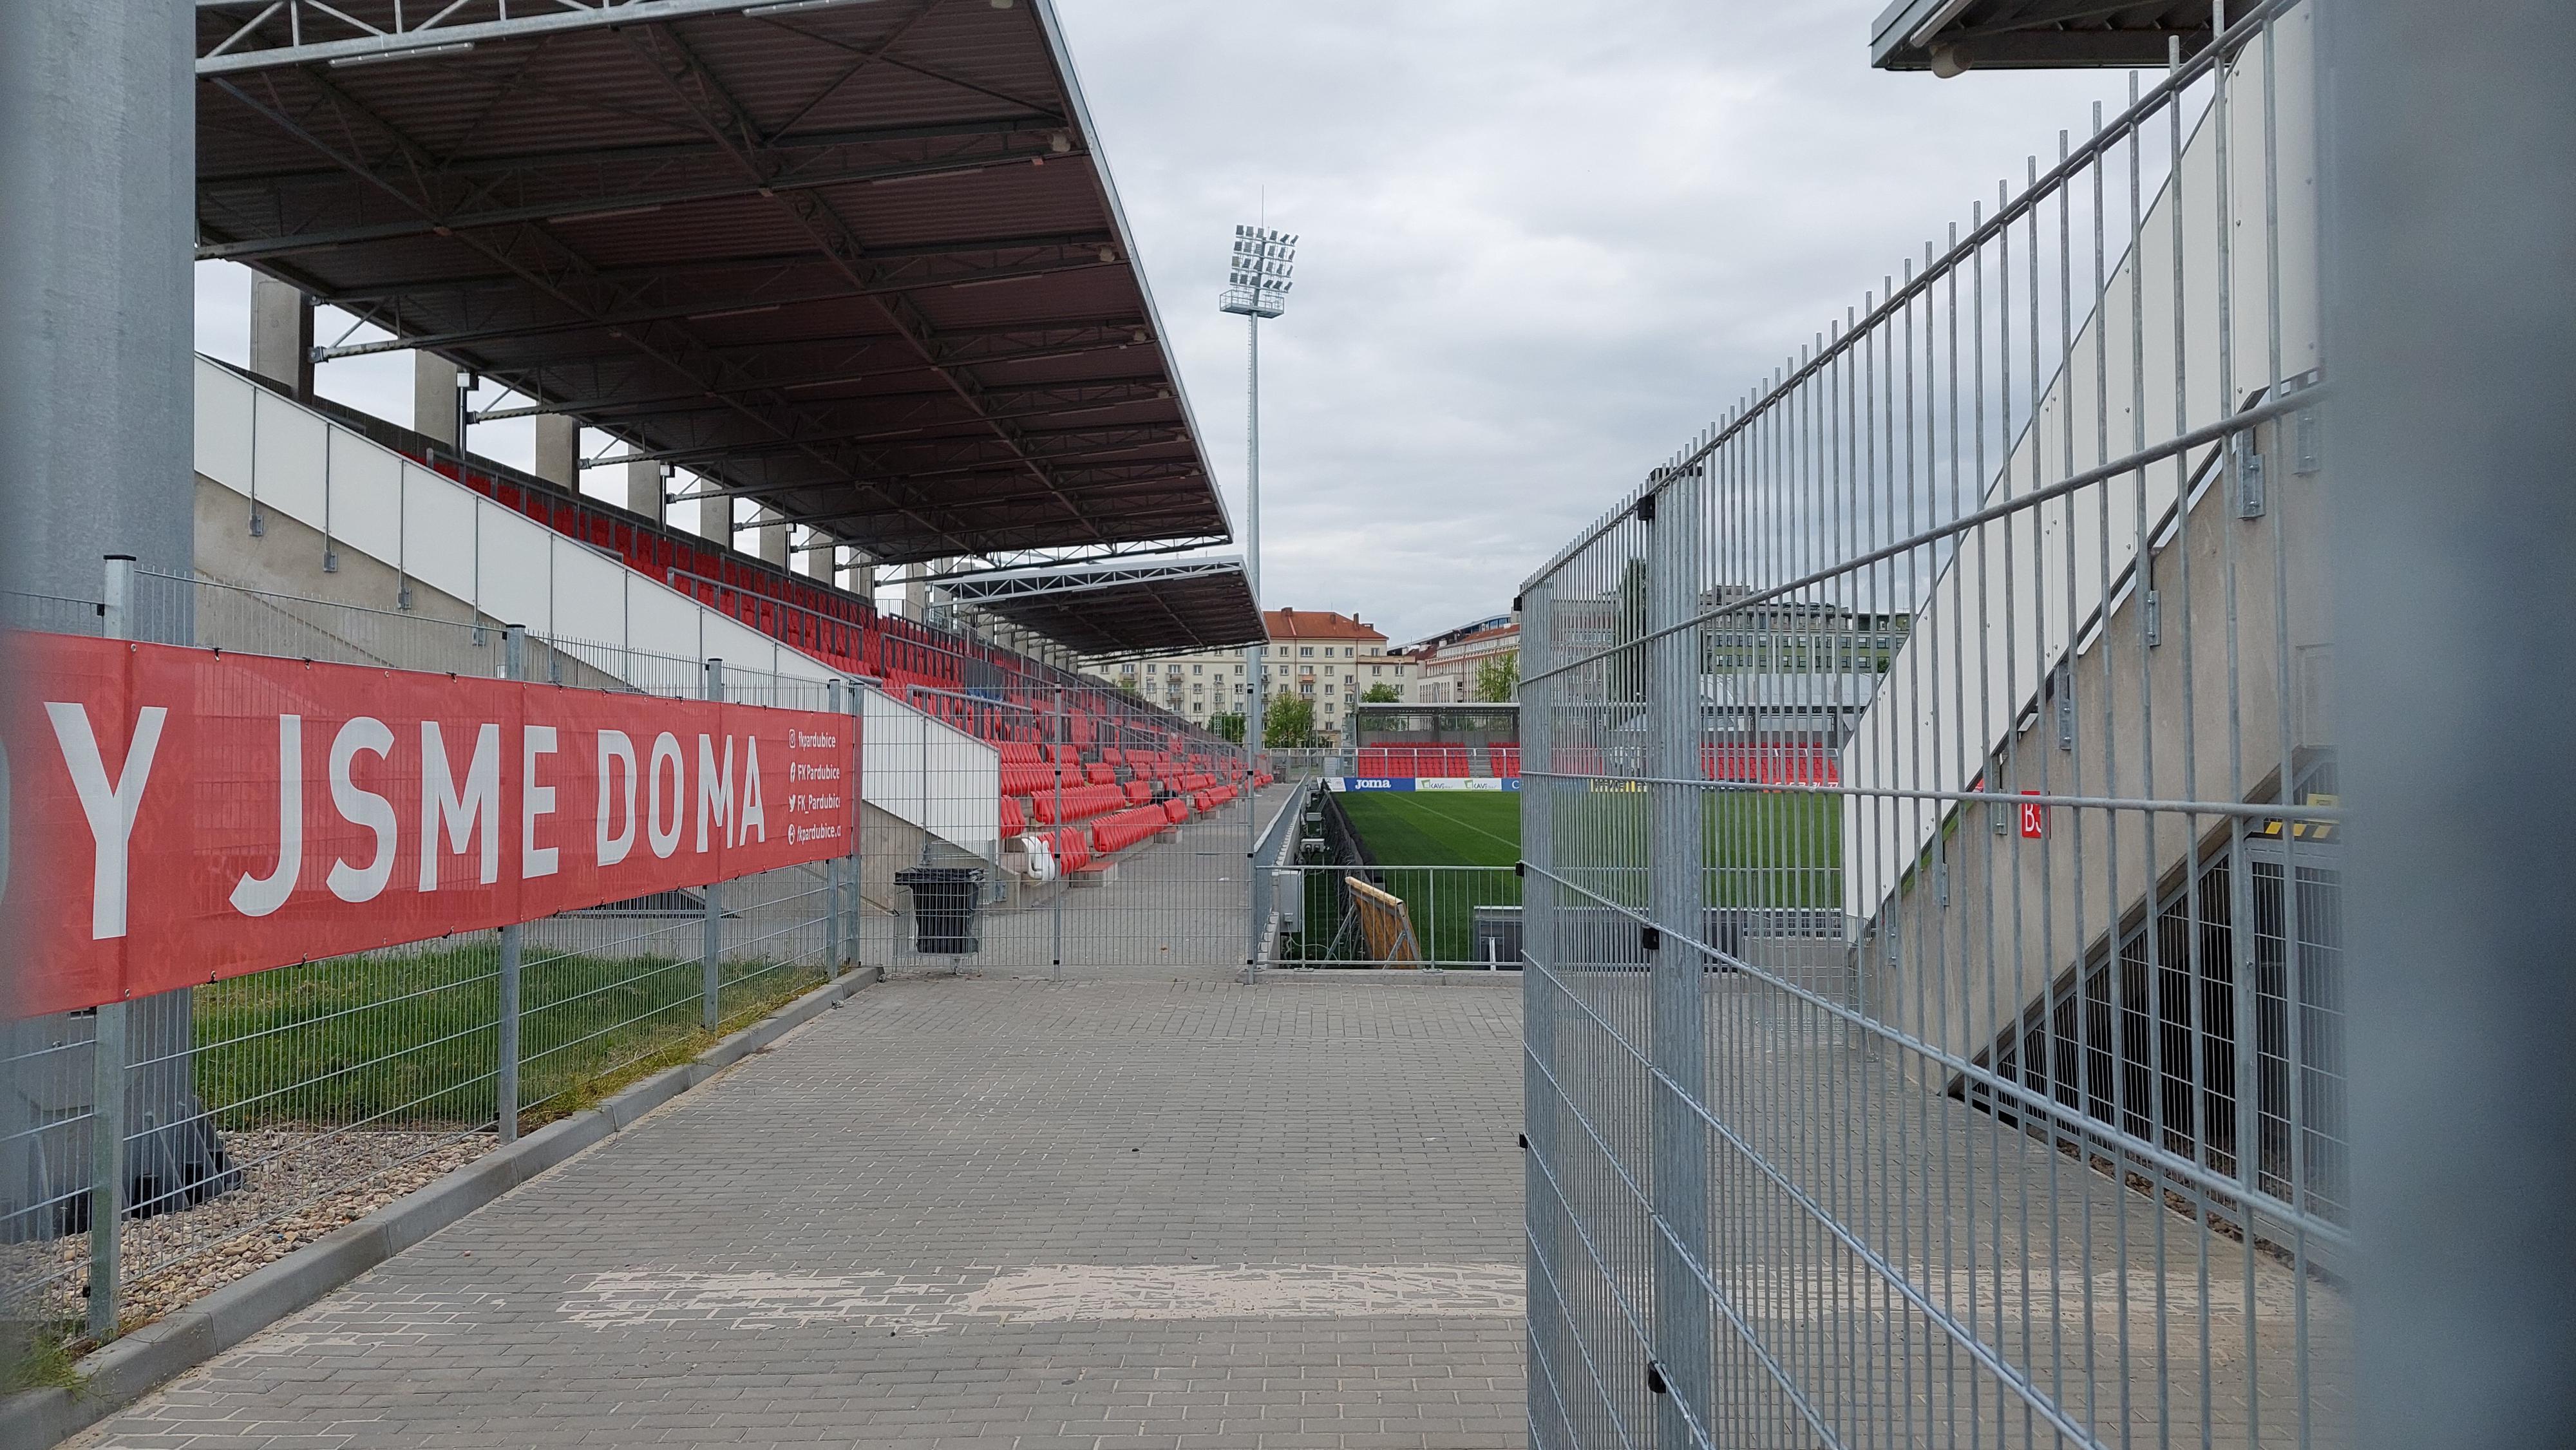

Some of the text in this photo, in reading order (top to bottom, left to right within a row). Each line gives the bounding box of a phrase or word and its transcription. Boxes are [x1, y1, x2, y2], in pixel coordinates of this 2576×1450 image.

[798, 731, 836, 751] fkpardubice
[797, 764, 840, 781] FK Pardubice
[229, 714, 558, 917] JSME
[596, 729, 765, 867] DOMA
